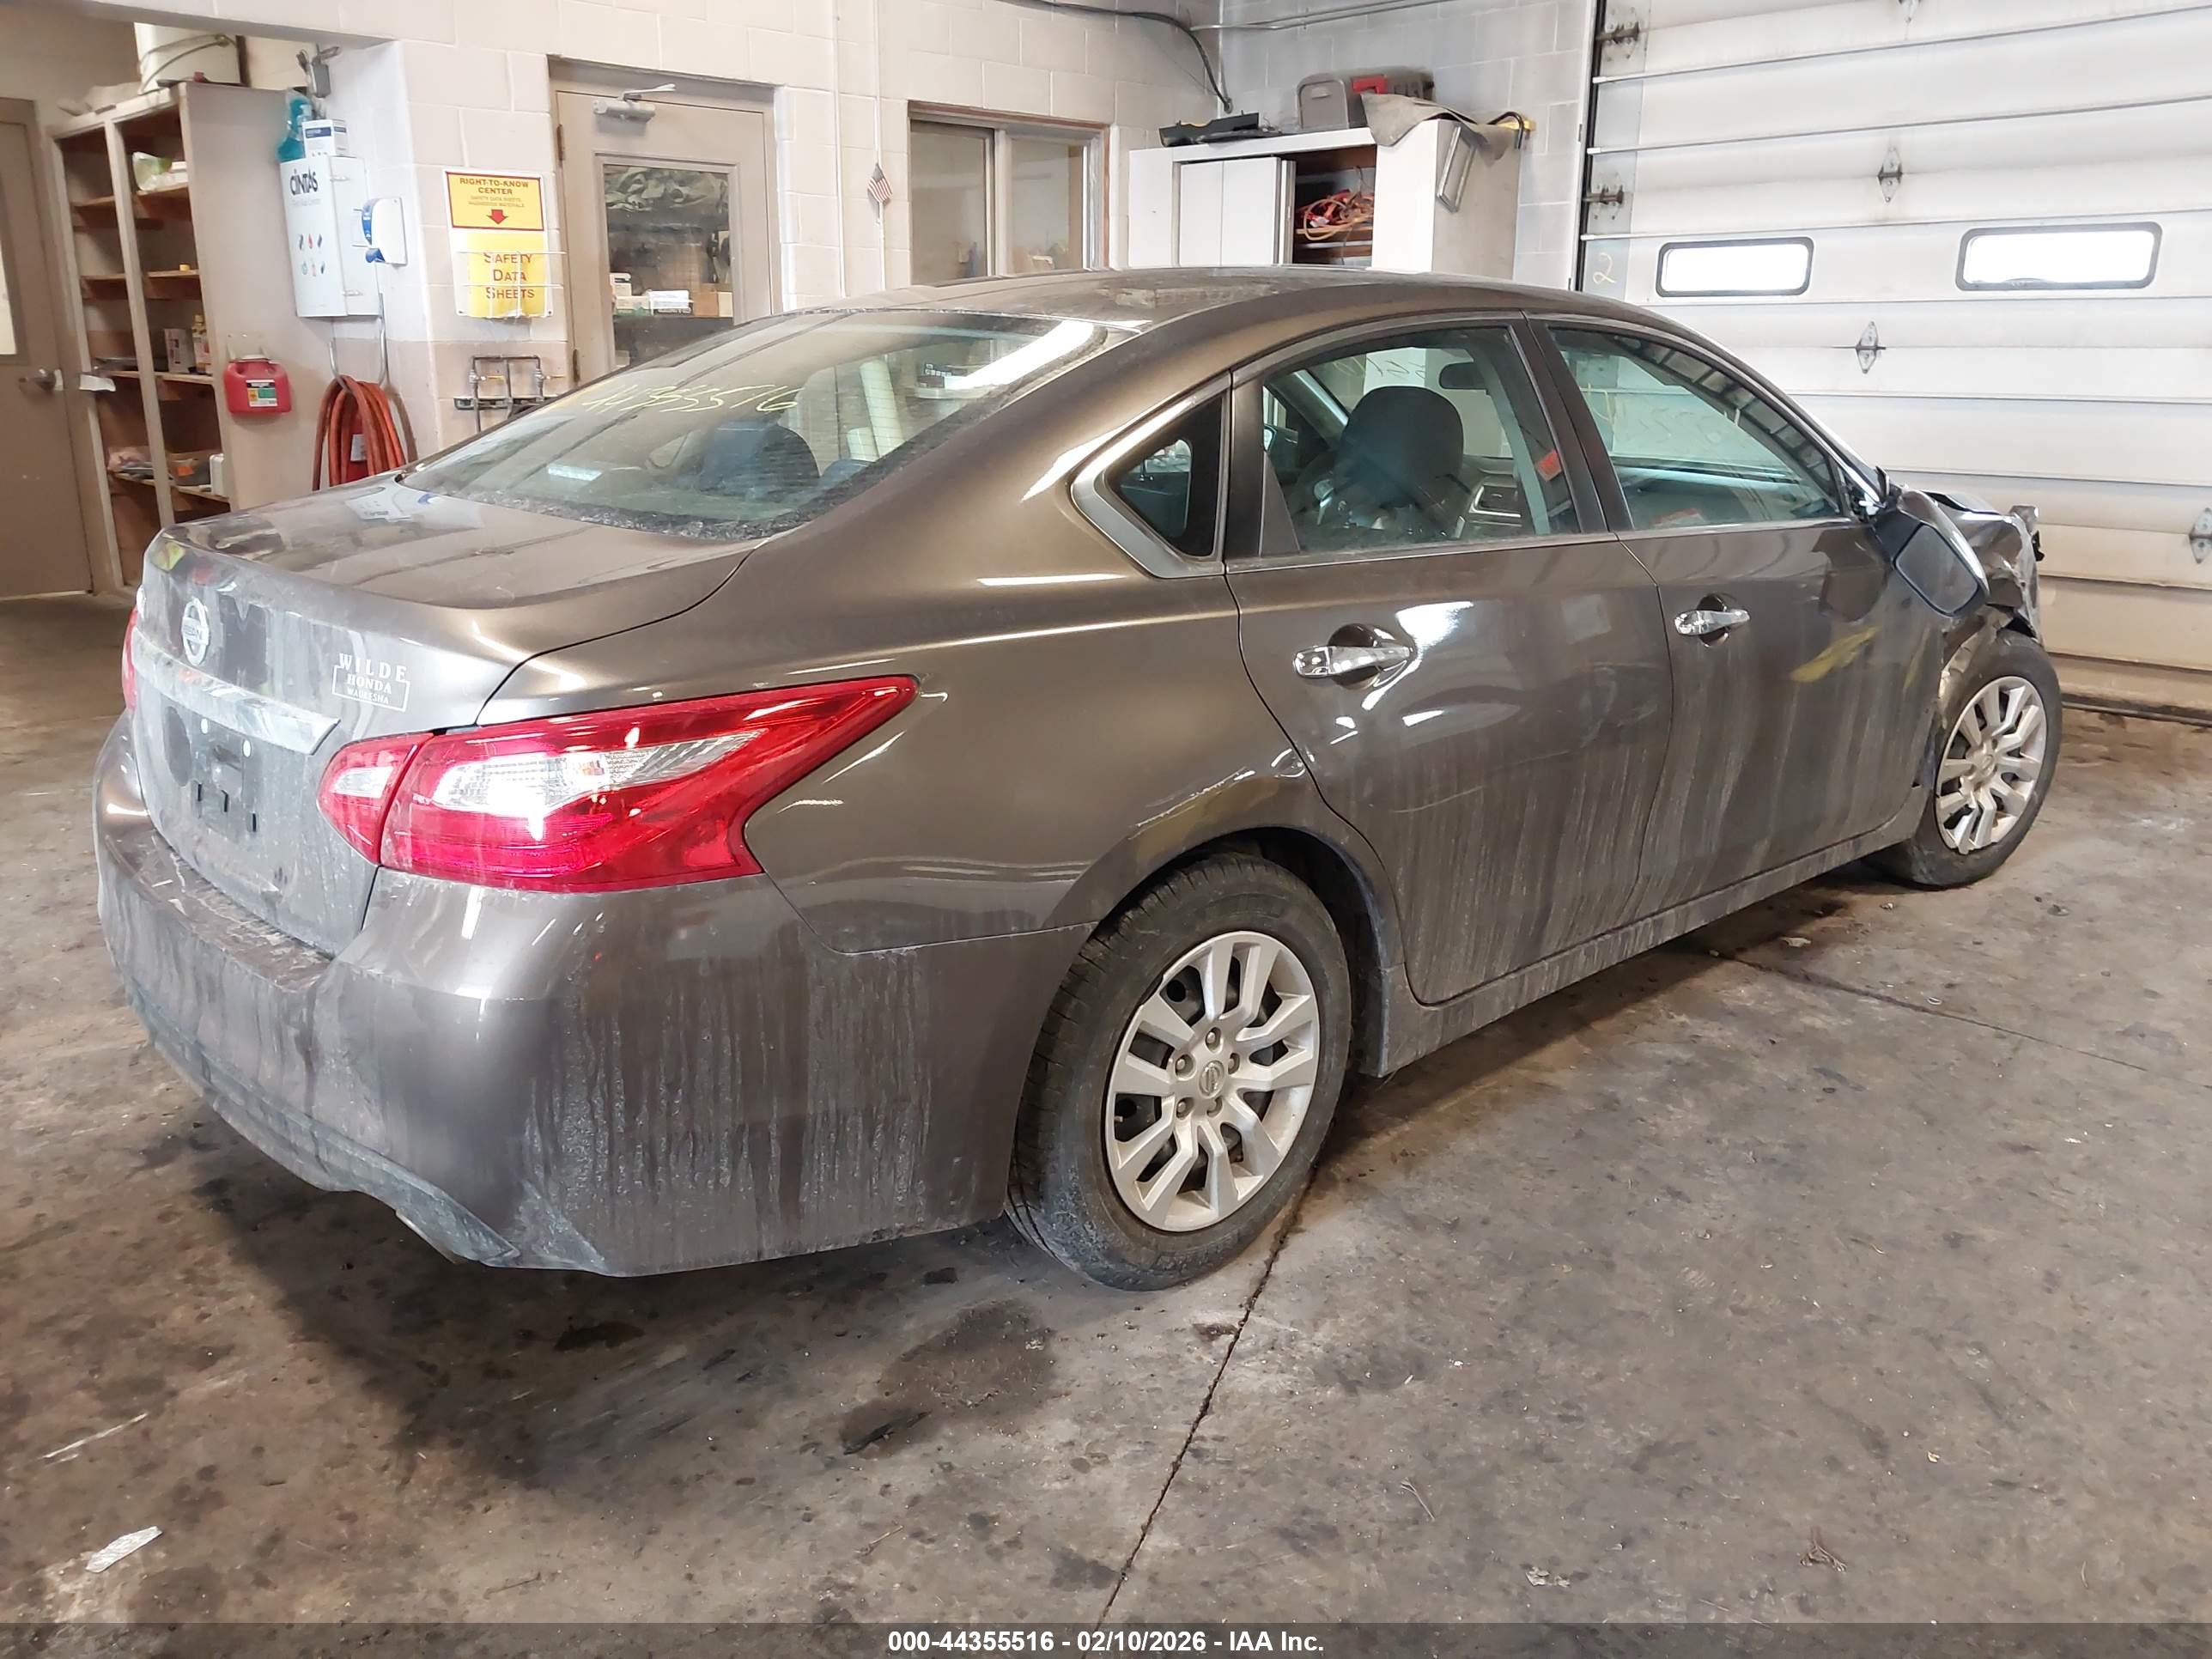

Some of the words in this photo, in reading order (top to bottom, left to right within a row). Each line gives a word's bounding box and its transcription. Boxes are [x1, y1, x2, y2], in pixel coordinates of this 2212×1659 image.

[289, 167, 319, 196] CINTAS
[459, 177, 529, 188] RIGHT-TO-KNOW
[477, 186, 513, 195] CENTER
[1593, 252, 1616, 284] 2
[339, 653, 407, 683] WILDE
[347, 673, 392, 695] HONDA
